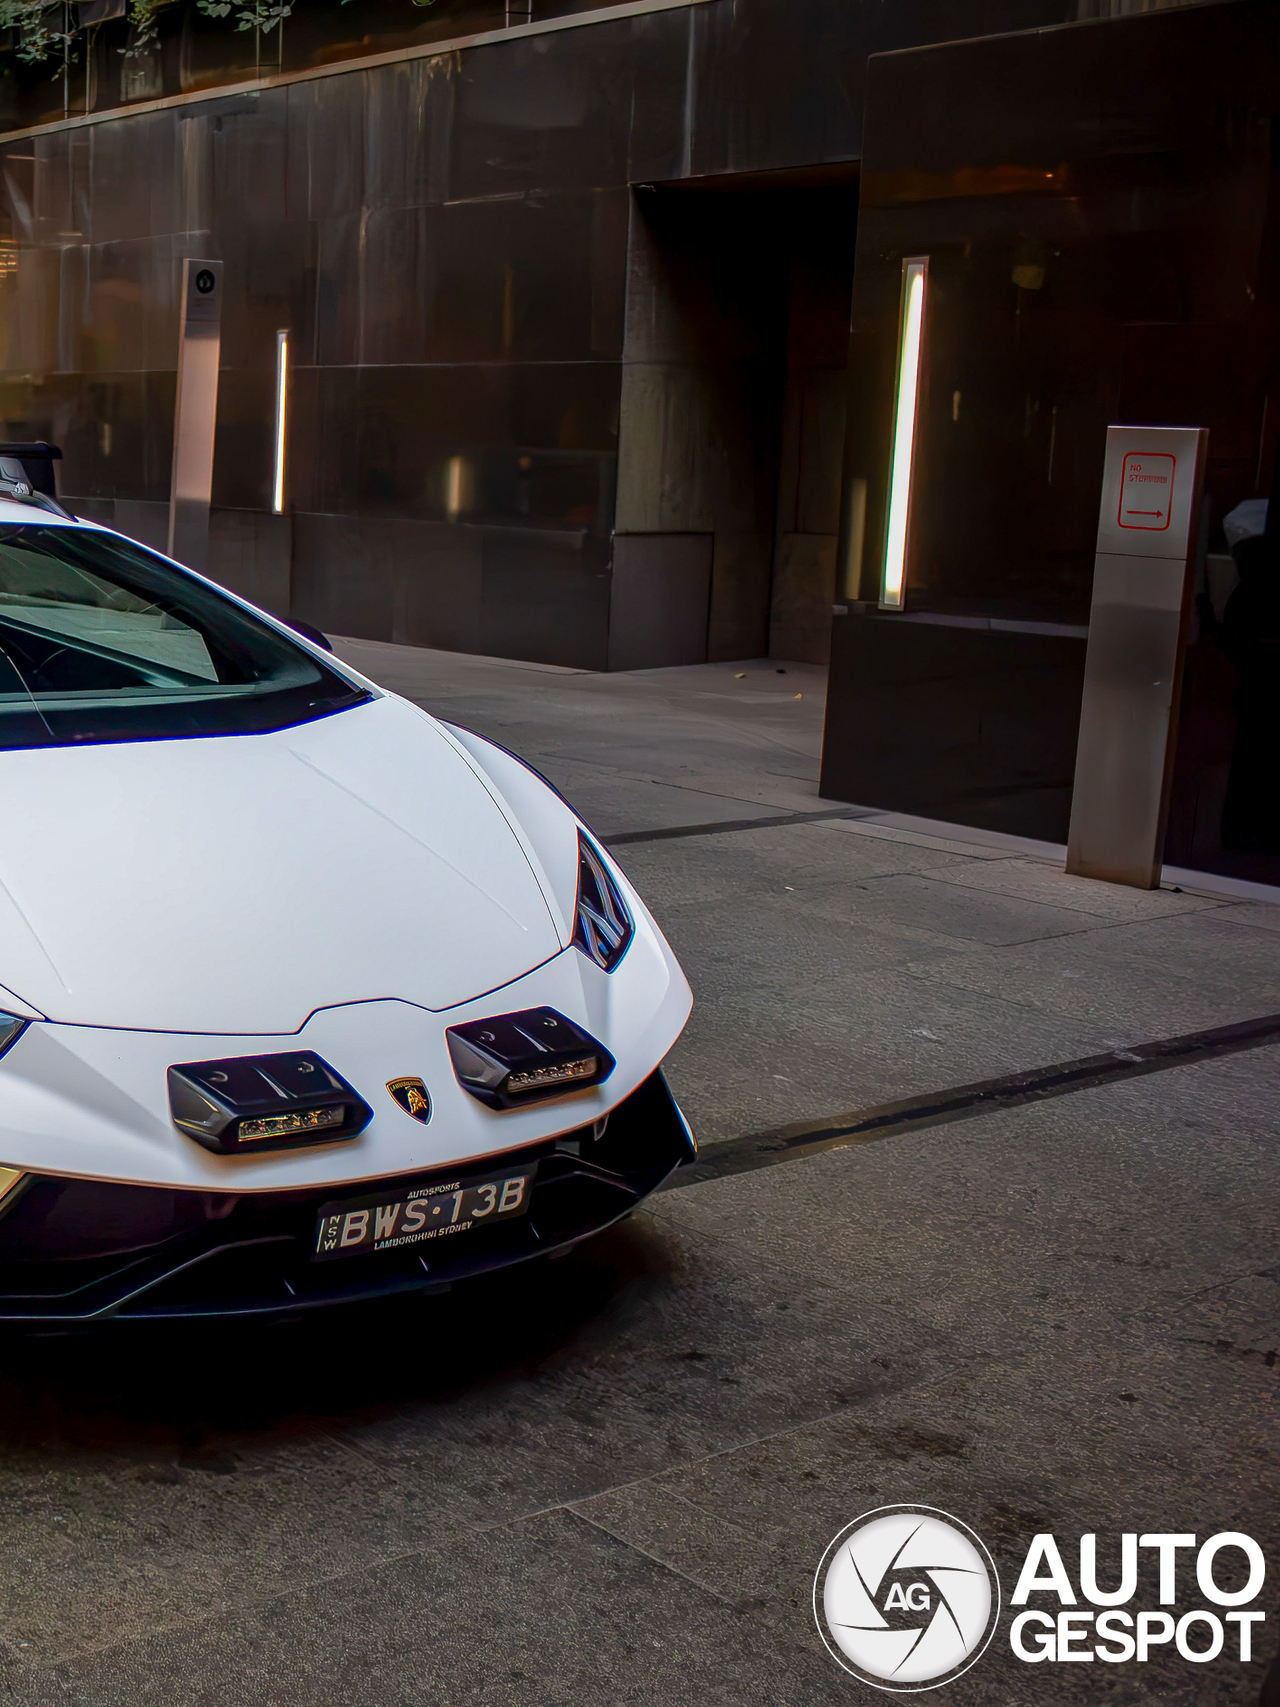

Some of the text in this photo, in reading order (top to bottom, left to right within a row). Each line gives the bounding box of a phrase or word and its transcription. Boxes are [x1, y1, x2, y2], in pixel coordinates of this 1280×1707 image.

[1130, 464, 1142, 472] NO
[1129, 474, 1168, 484] STOPP
[438, 1220, 473, 1237] SYDNEY
